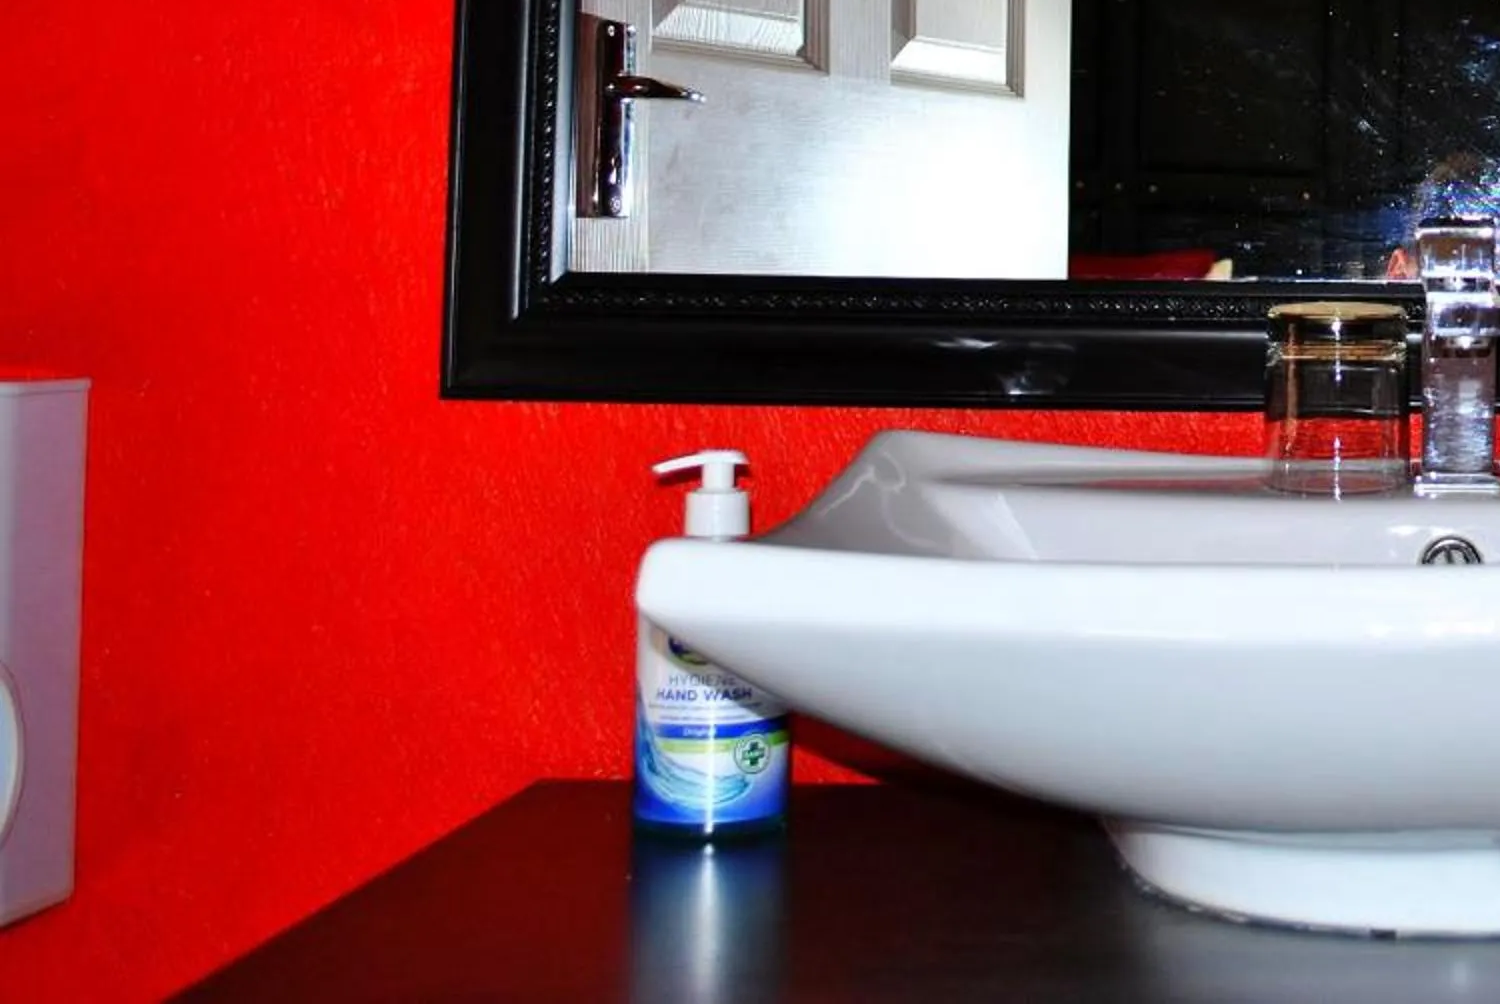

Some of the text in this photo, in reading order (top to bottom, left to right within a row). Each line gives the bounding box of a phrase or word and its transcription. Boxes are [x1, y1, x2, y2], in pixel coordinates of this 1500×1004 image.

[668, 673, 737, 687] HYGIENE
[656, 687, 752, 701] HAND WASH
